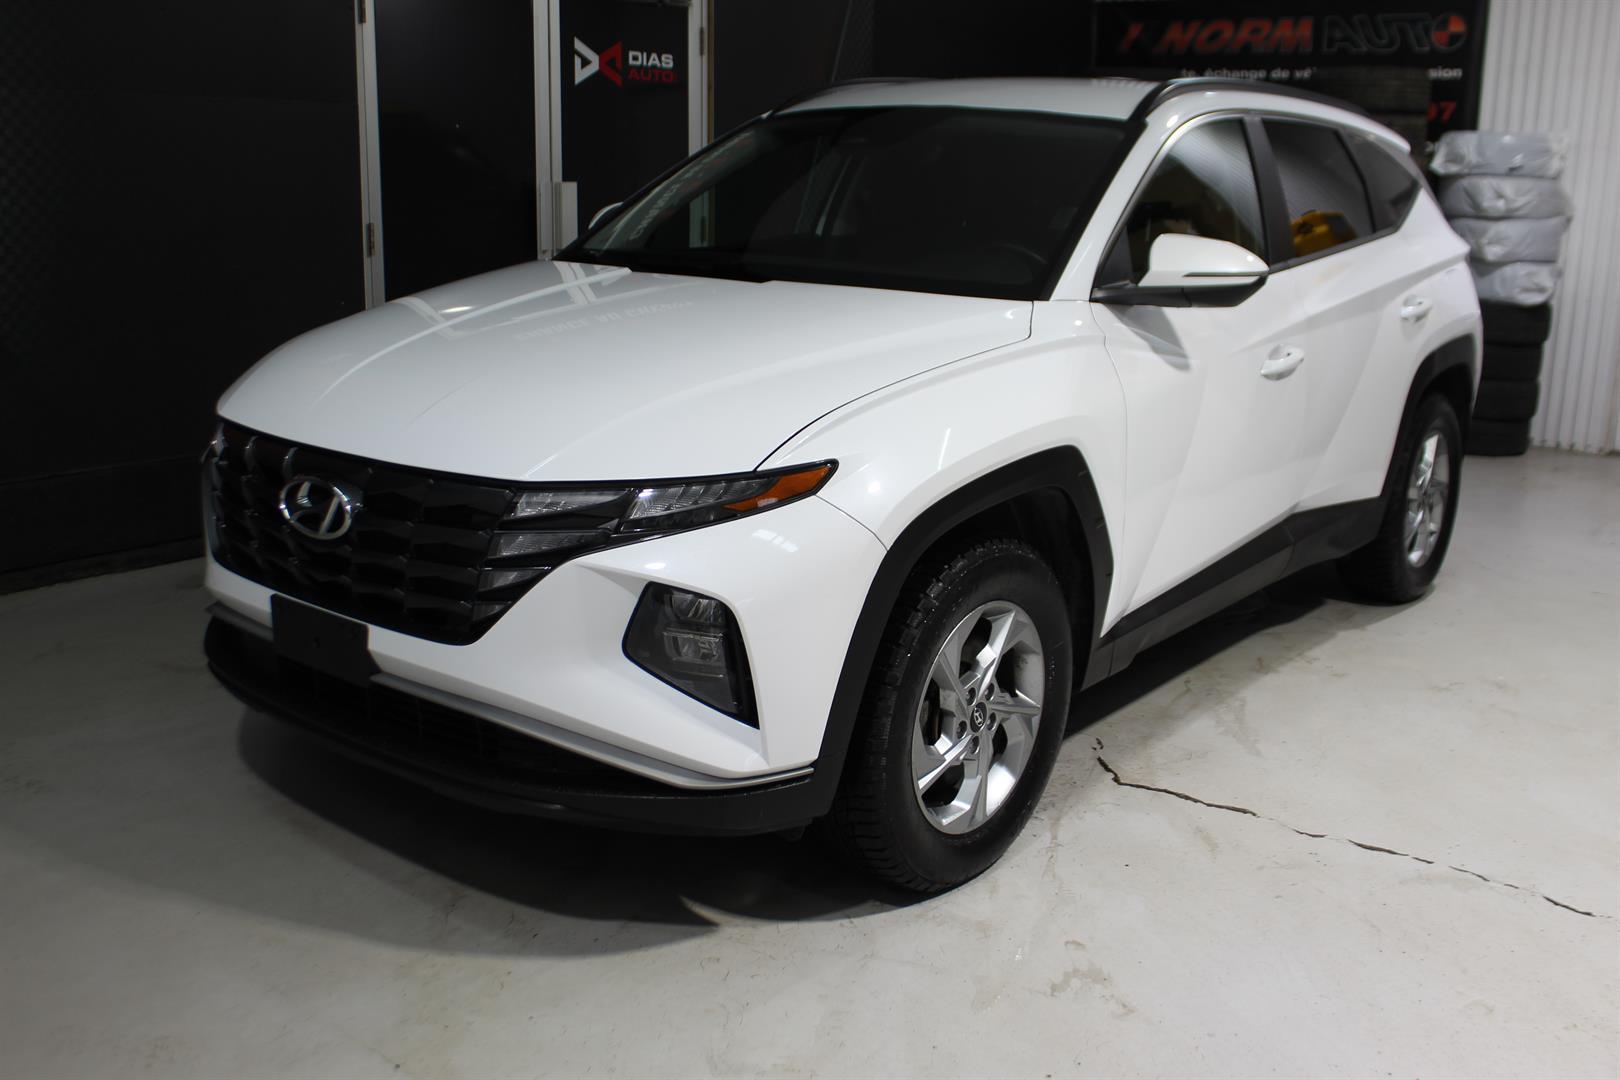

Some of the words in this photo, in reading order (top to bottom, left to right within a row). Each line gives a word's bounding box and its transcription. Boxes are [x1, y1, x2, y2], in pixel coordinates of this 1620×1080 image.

[628, 50, 674, 69] DIAS
[627, 67, 676, 85] AUTO
[1270, 67, 1290, 79] de
